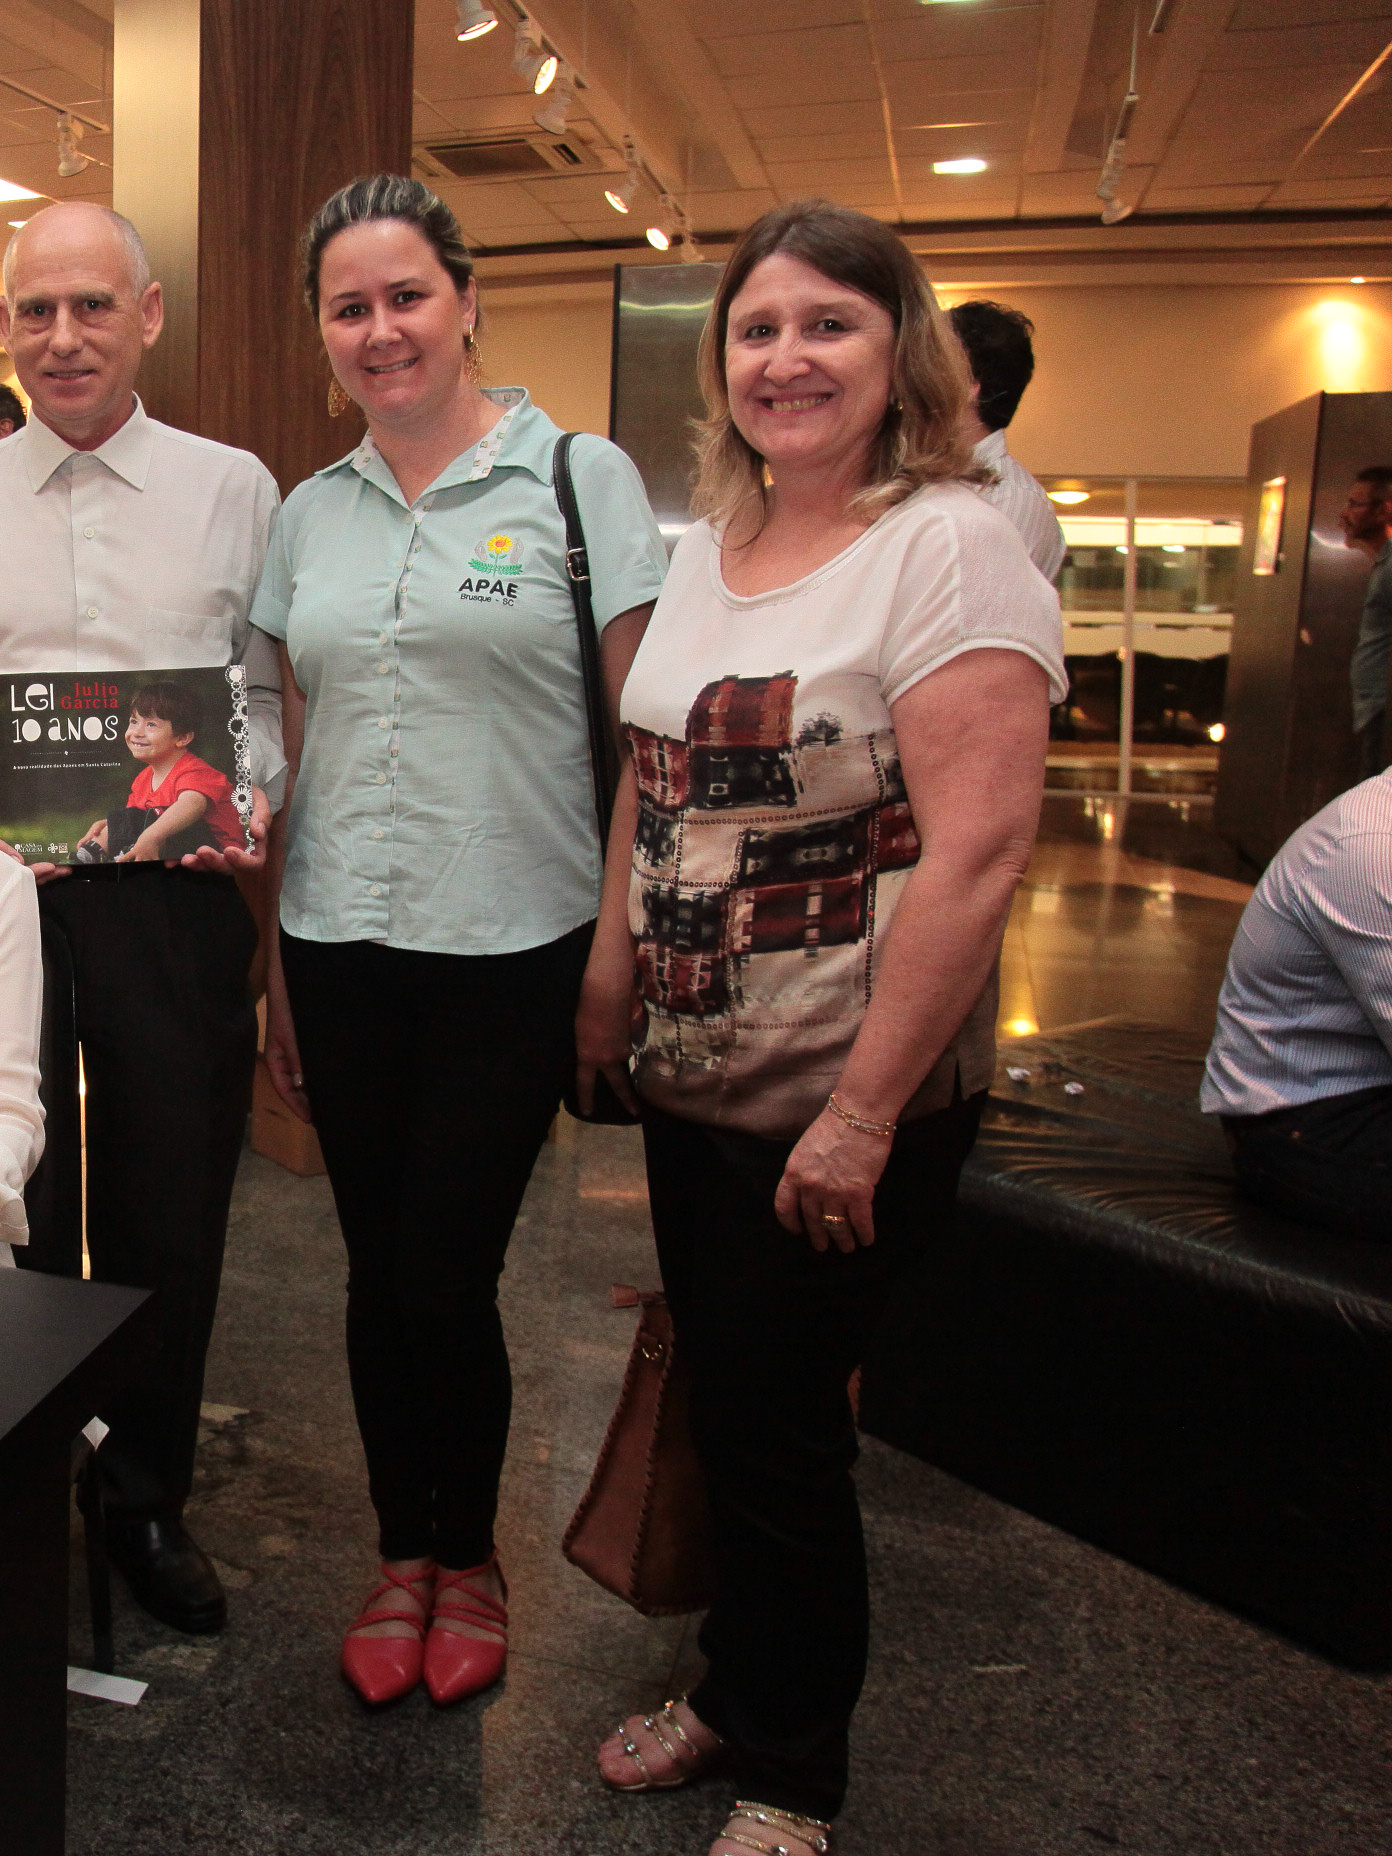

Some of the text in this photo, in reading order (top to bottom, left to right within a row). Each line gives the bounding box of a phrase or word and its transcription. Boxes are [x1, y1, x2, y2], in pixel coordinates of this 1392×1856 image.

[458, 578, 518, 598] APAE
[460, 593, 492, 603] Brusque
[502, 598, 514, 607] SC
[74, 682, 119, 698] Julio
[11, 718, 42, 743] 10
